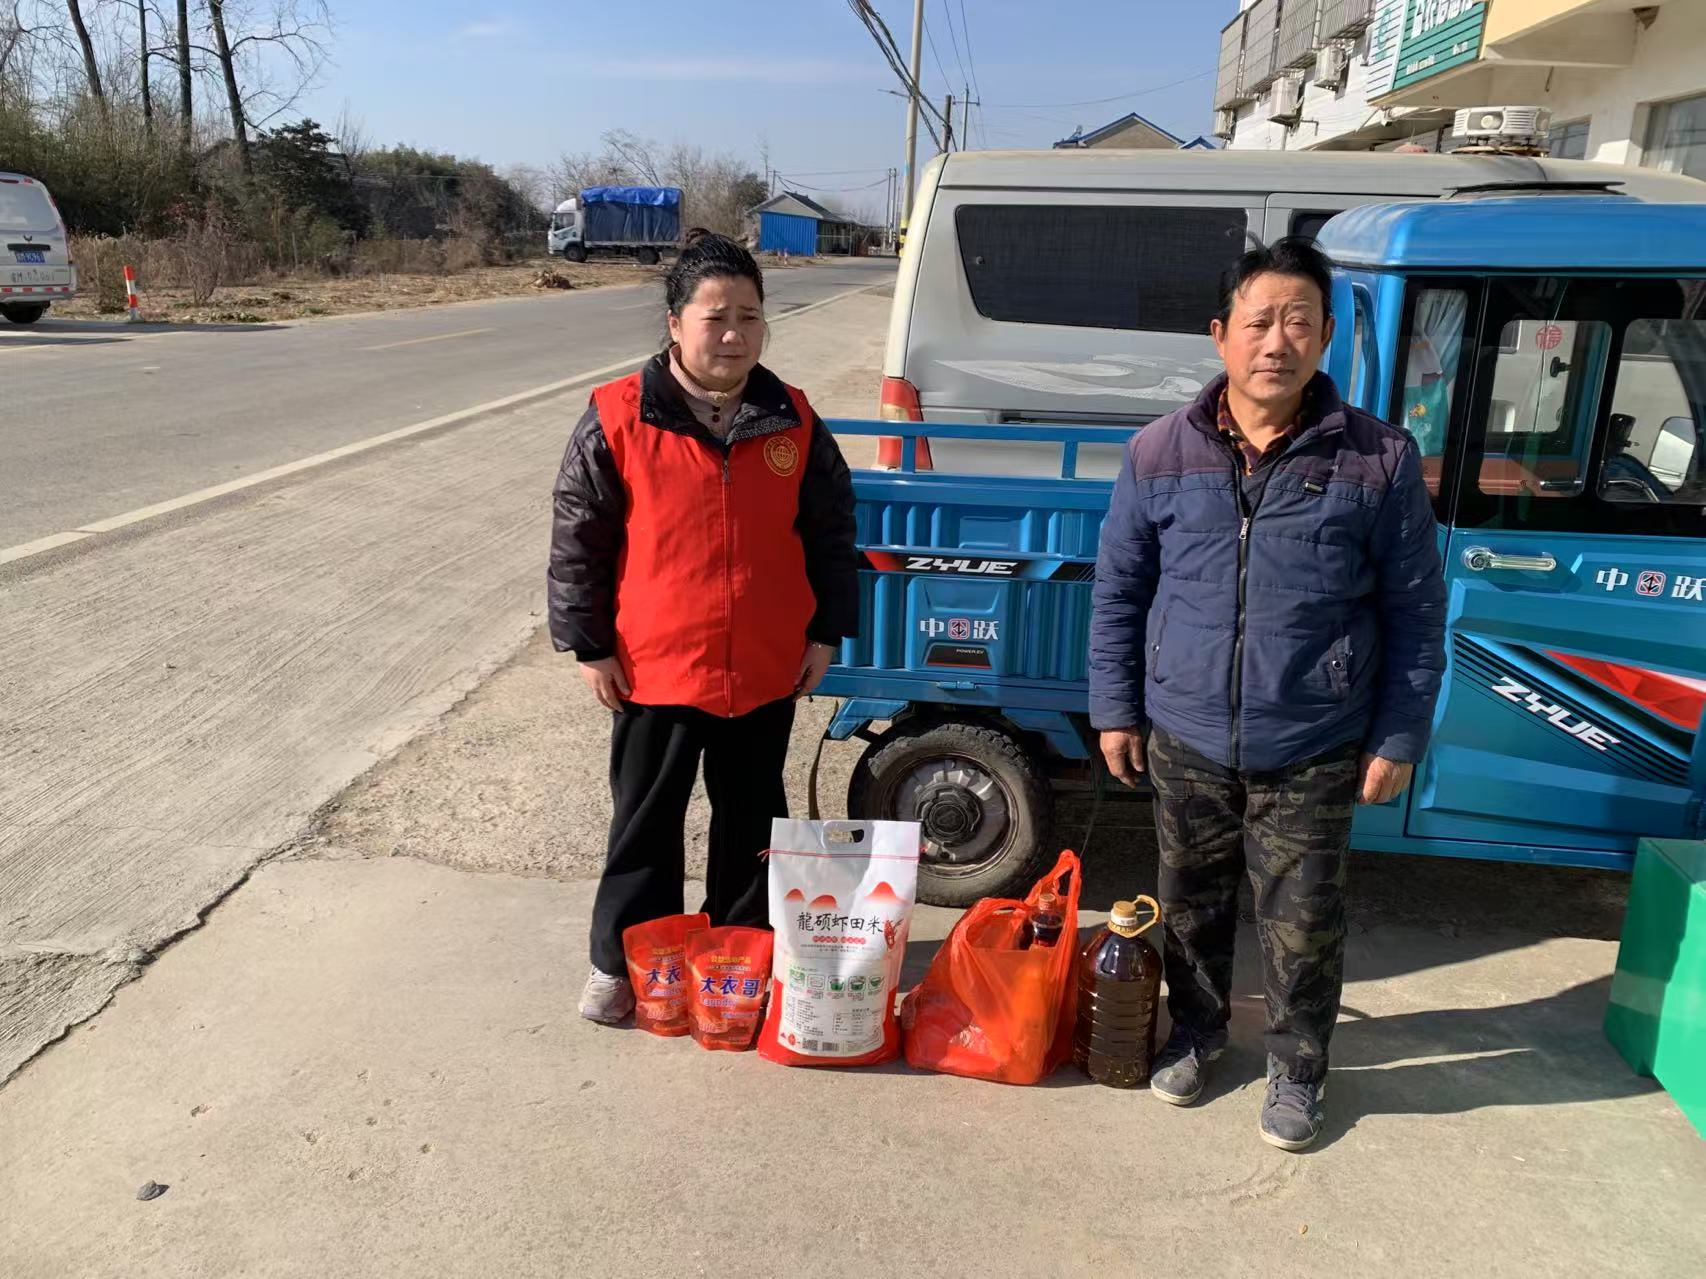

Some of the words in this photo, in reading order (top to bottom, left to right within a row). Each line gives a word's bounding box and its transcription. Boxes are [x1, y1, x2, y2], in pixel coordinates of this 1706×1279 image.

[905, 557, 1018, 575] ZYUE
[1596, 567, 1629, 591] 中
[920, 617, 945, 638] 中
[973, 620, 1000, 641] 跃
[1492, 676, 1621, 751] ZYUE
[796, 912, 884, 934] 龍硕虾田米
[700, 975, 761, 998] 大衣哥
